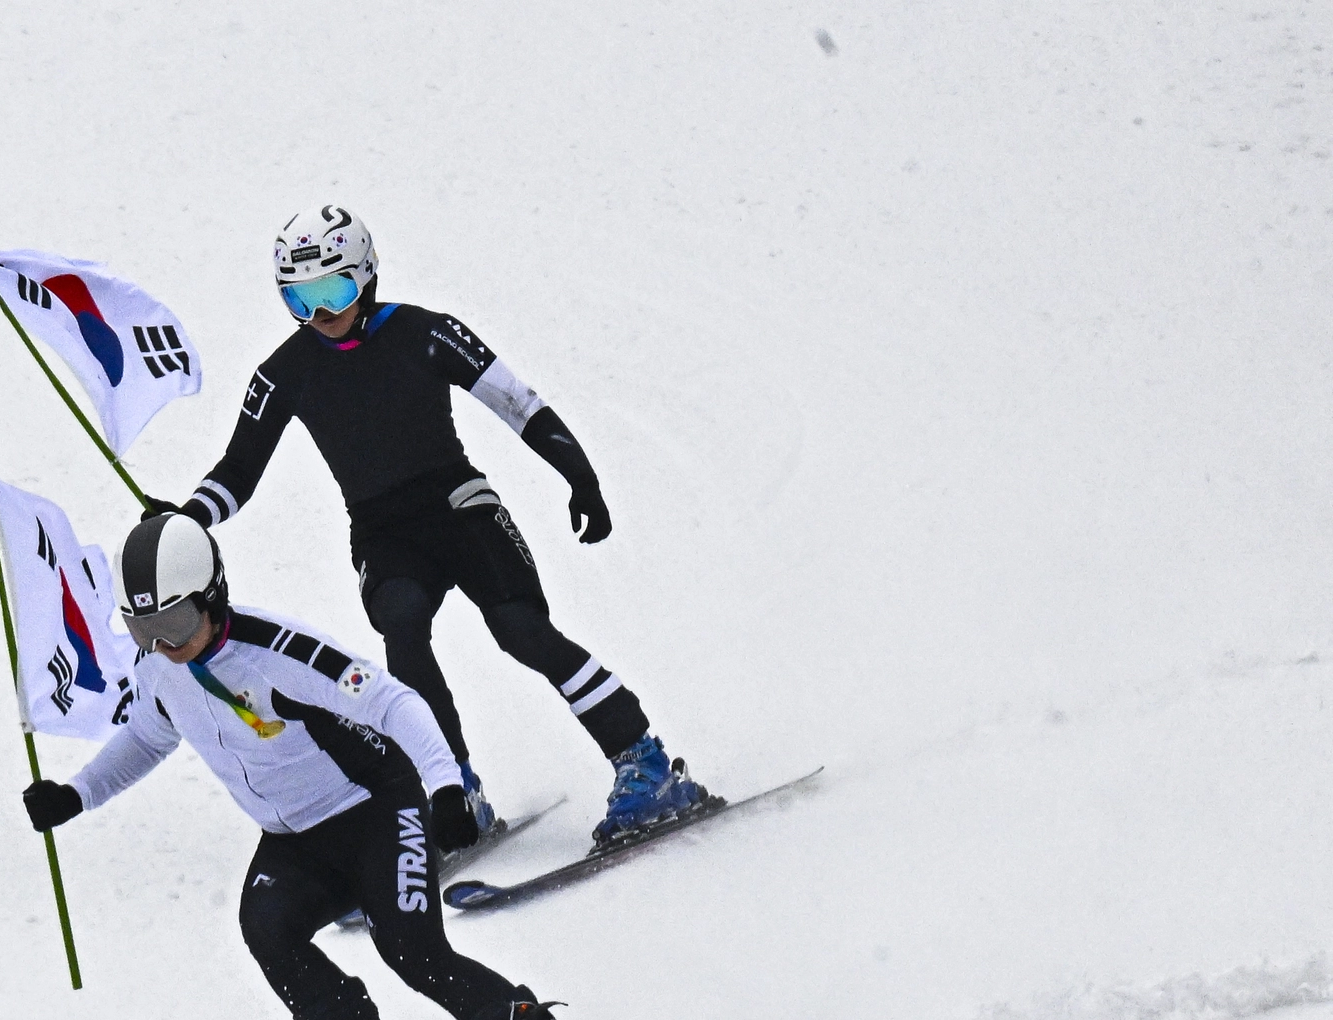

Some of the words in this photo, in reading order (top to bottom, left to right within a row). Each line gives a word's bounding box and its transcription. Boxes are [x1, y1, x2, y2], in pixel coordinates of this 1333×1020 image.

[430, 330, 457, 349] RACING
[456, 346, 480, 371] SCHOOL
[397, 807, 428, 913] STRAVA
